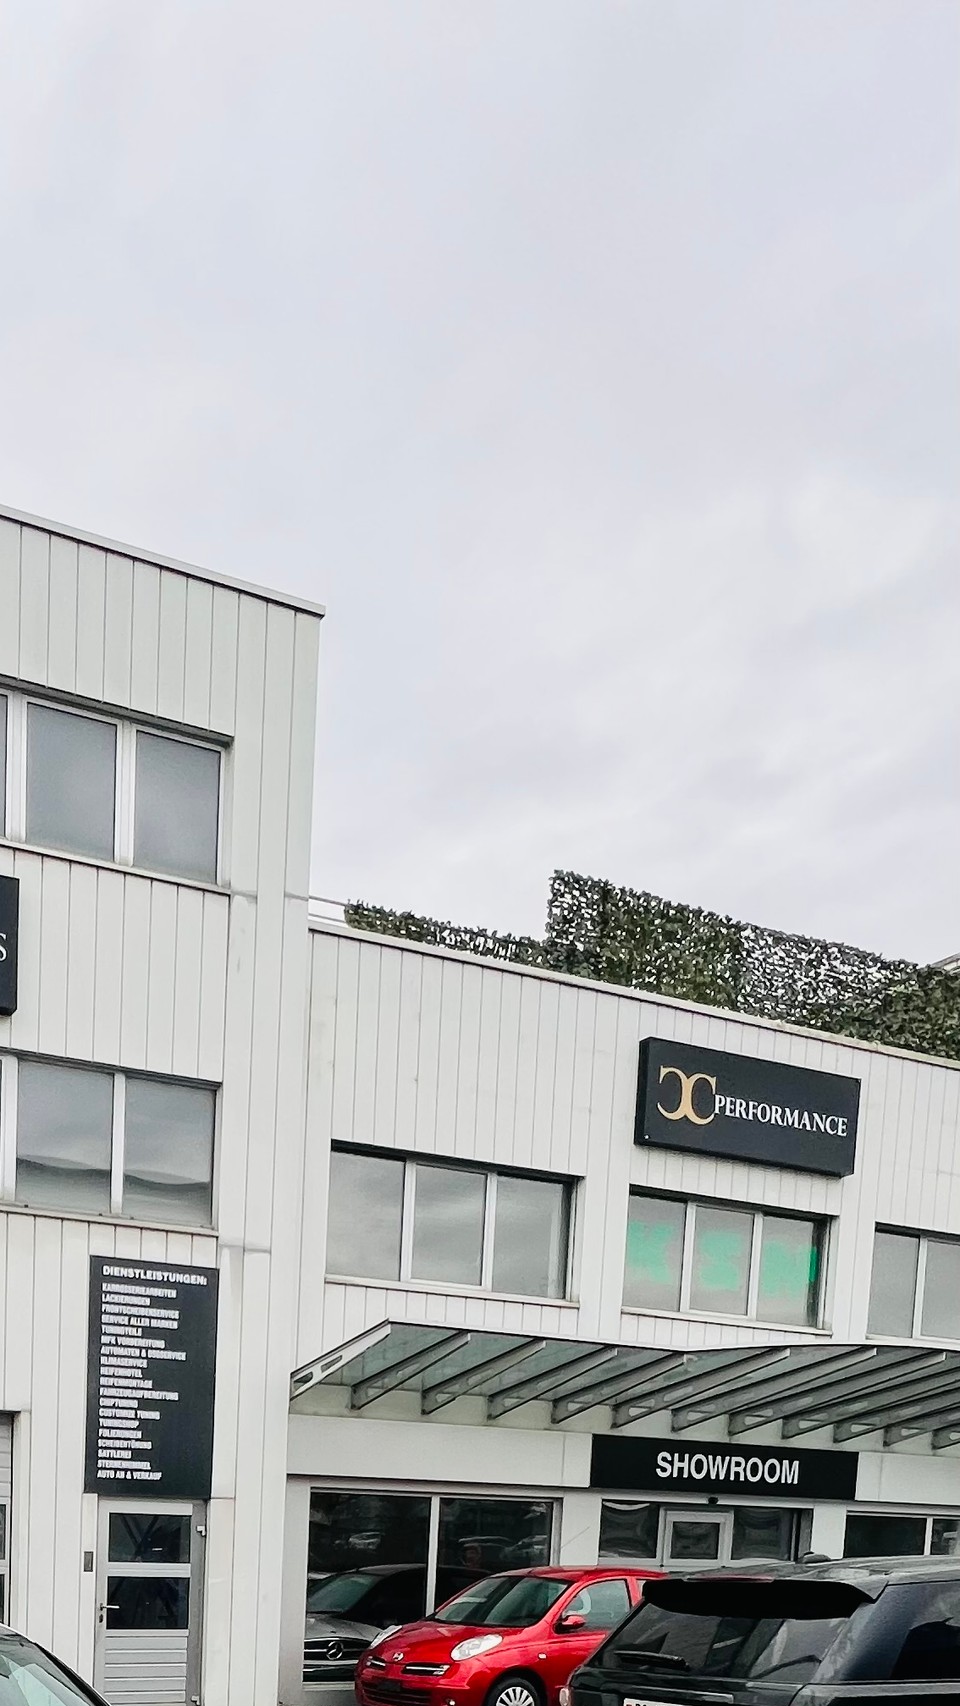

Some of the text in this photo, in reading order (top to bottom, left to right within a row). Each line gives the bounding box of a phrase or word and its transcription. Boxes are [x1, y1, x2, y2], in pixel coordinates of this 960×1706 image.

[714, 1094, 848, 1137] PERFORMANCE
[103, 1265, 208, 1286] DIENSTLEISTUNGEN:
[655, 1451, 800, 1485] SHOWROOM
